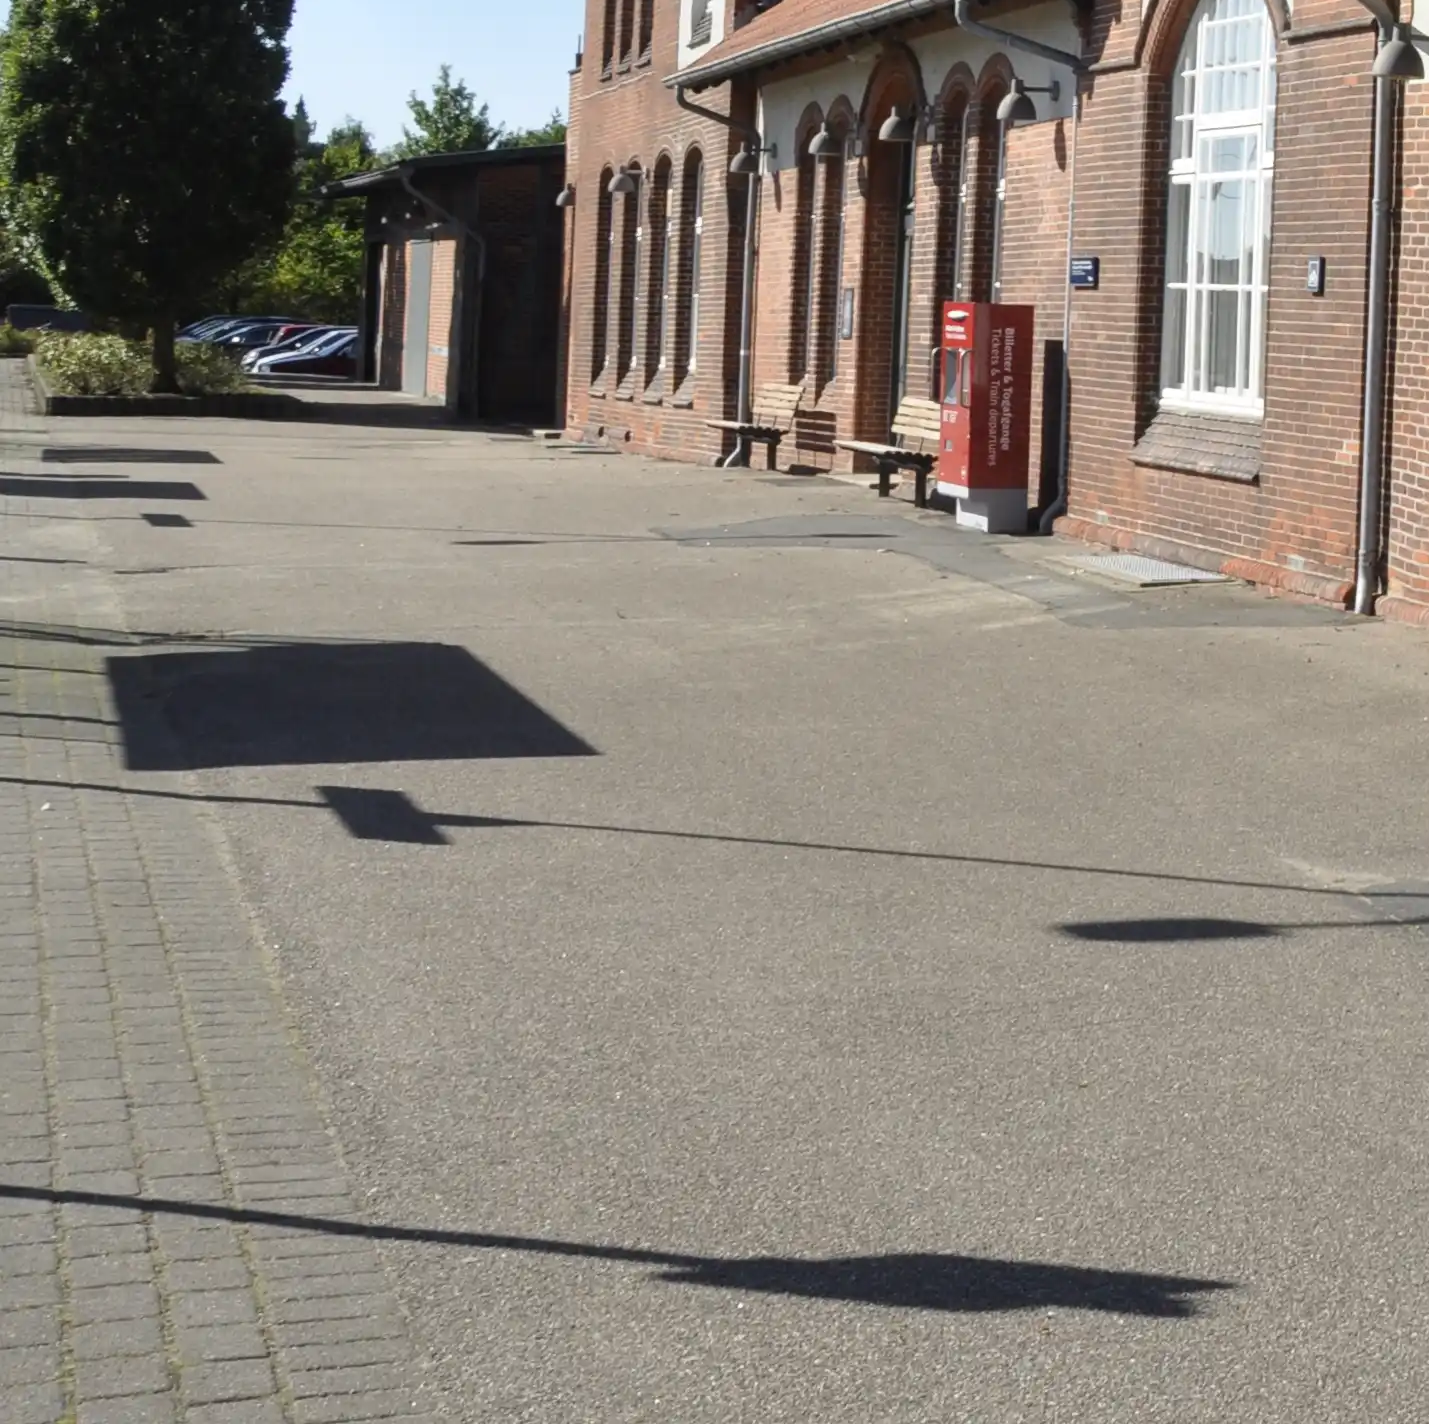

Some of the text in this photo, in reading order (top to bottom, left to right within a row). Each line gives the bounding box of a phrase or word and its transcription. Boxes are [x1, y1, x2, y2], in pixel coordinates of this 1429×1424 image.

[1003, 327, 1016, 372] Billetter
[987, 328, 1003, 467] Tickets & Train departures
[1003, 375, 1014, 384] &
